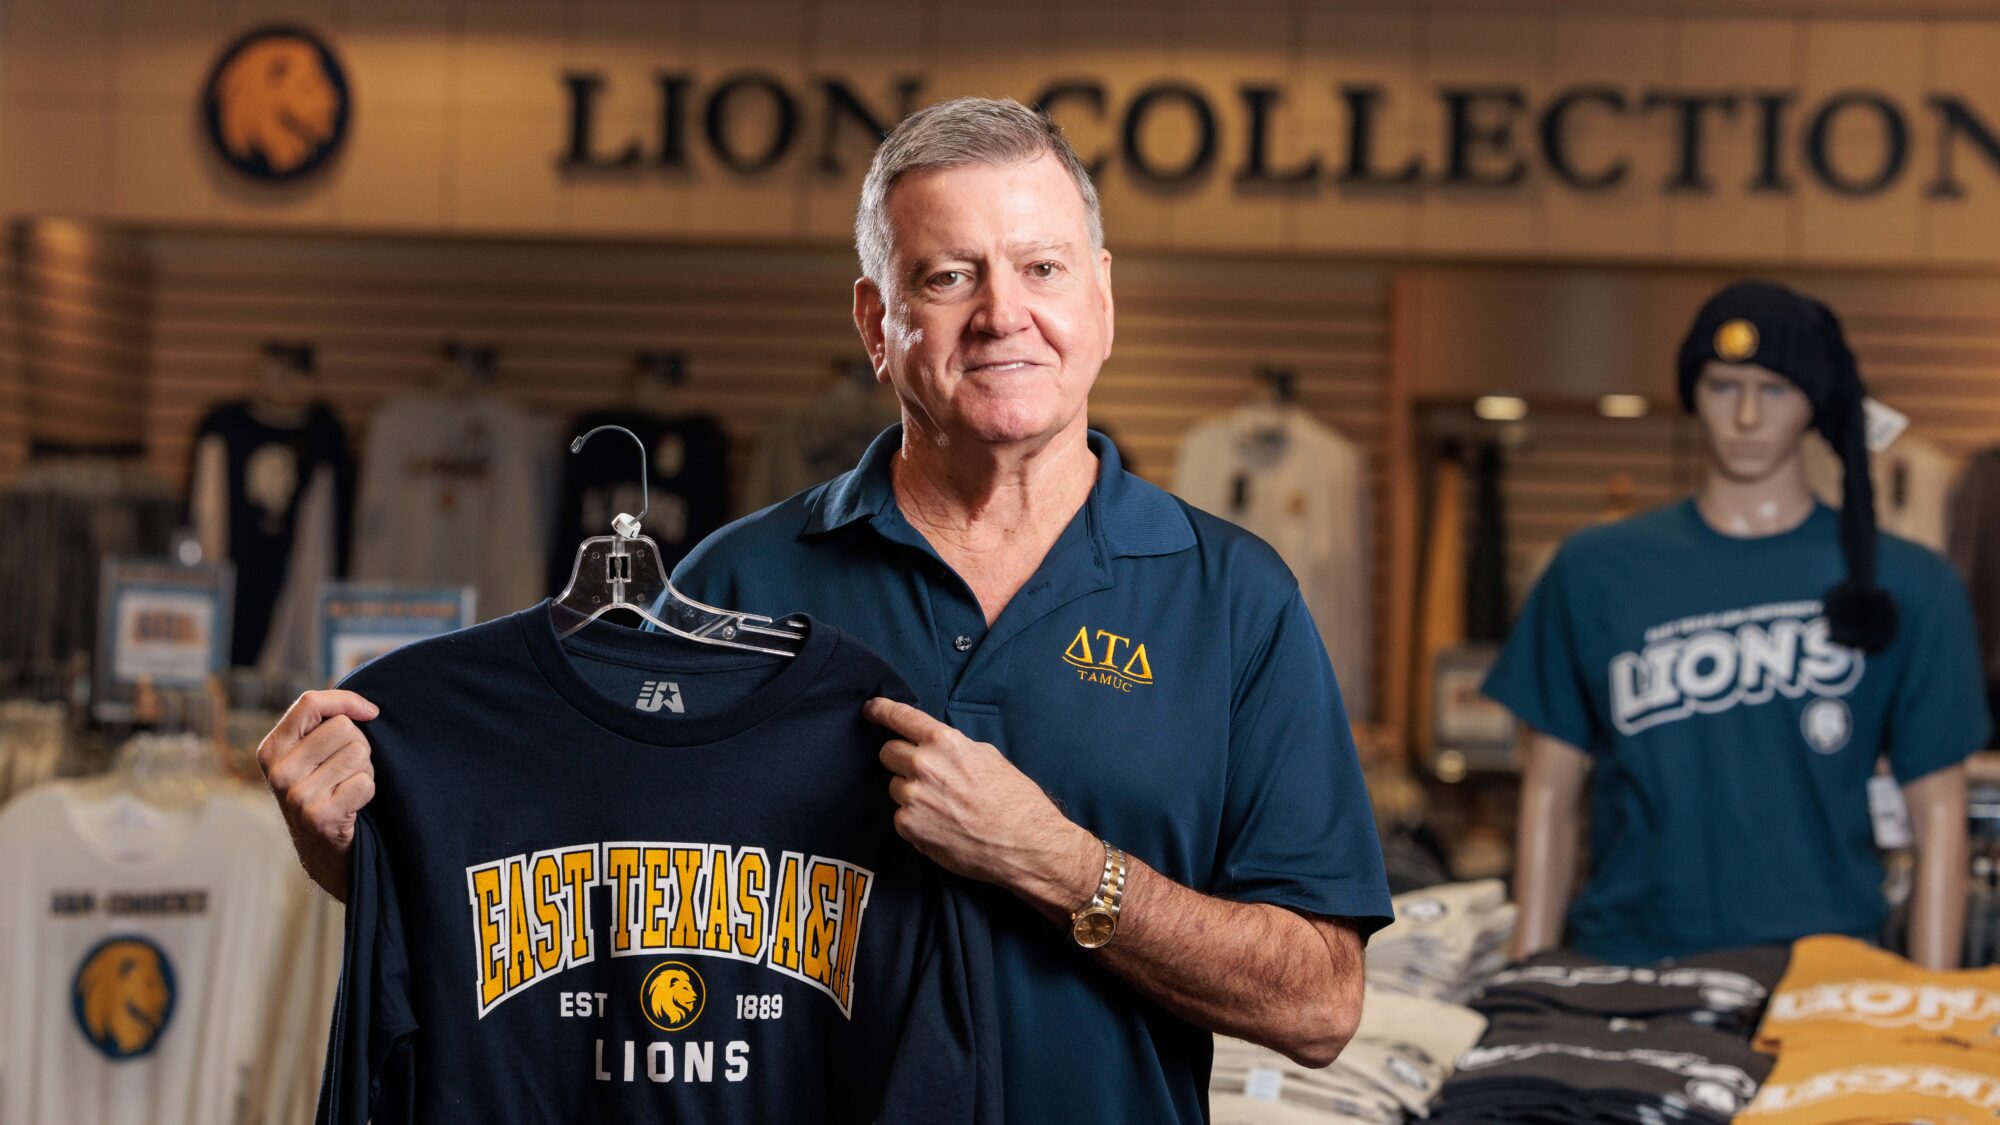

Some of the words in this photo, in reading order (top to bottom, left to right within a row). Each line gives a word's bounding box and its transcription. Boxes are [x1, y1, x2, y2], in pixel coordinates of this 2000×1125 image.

[558, 72, 928, 178] LION
[1077, 669, 1133, 693] TAMUC
[1608, 615, 1866, 736] LIONS
[466, 842, 601, 1020] EAST
[602, 841, 771, 965] TEXAS
[766, 850, 875, 1021] A&M
[559, 991, 608, 1018] EST
[735, 993, 784, 1020] 1889
[1769, 979, 2000, 1031] LION
[595, 1039, 750, 1083] LIONS
